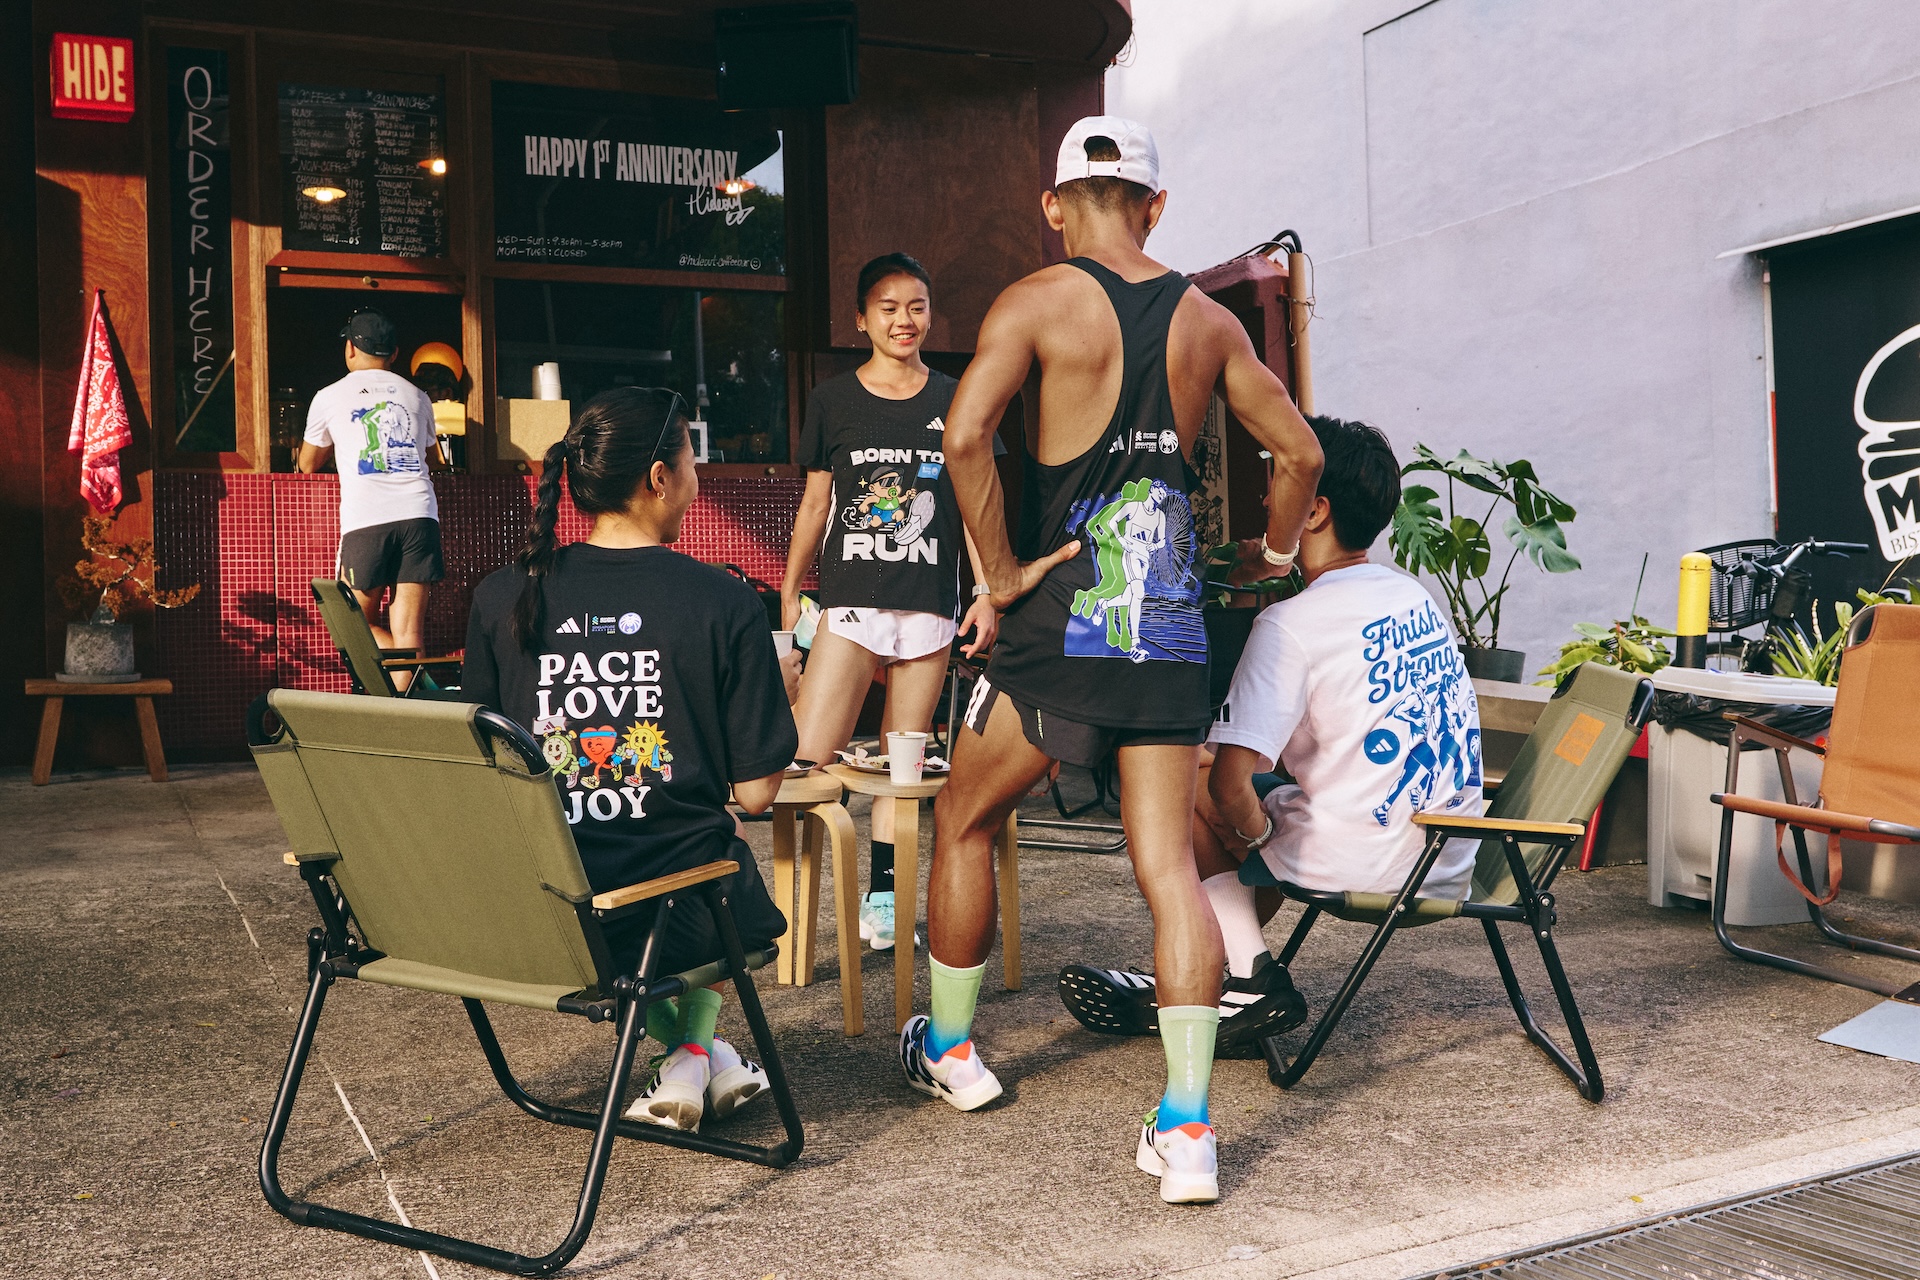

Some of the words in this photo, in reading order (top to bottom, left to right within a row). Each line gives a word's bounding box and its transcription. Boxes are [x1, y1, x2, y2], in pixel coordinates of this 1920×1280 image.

[63, 42, 126, 103] HIDE
[297, 90, 336, 104] COFFEE
[184, 66, 216, 255] ORDER
[525, 135, 588, 178] HAPPY
[593, 139, 611, 180] 1ST
[616, 142, 738, 187] ANNIVERSARY
[189, 266, 212, 395] HERE
[850, 448, 912, 466] BORN
[916, 449, 945, 465] TO
[842, 533, 938, 565] RUN
[1890, 530, 1920, 555] BIS
[1362, 600, 1448, 662] Finish
[538, 649, 661, 686] PACE
[1368, 644, 1465, 704] Strong
[536, 685, 664, 720] LOVE
[565, 785, 651, 825] JOY
[1186, 1025, 1194, 1055] FEEL
[1186, 1060, 1194, 1092] FAST
